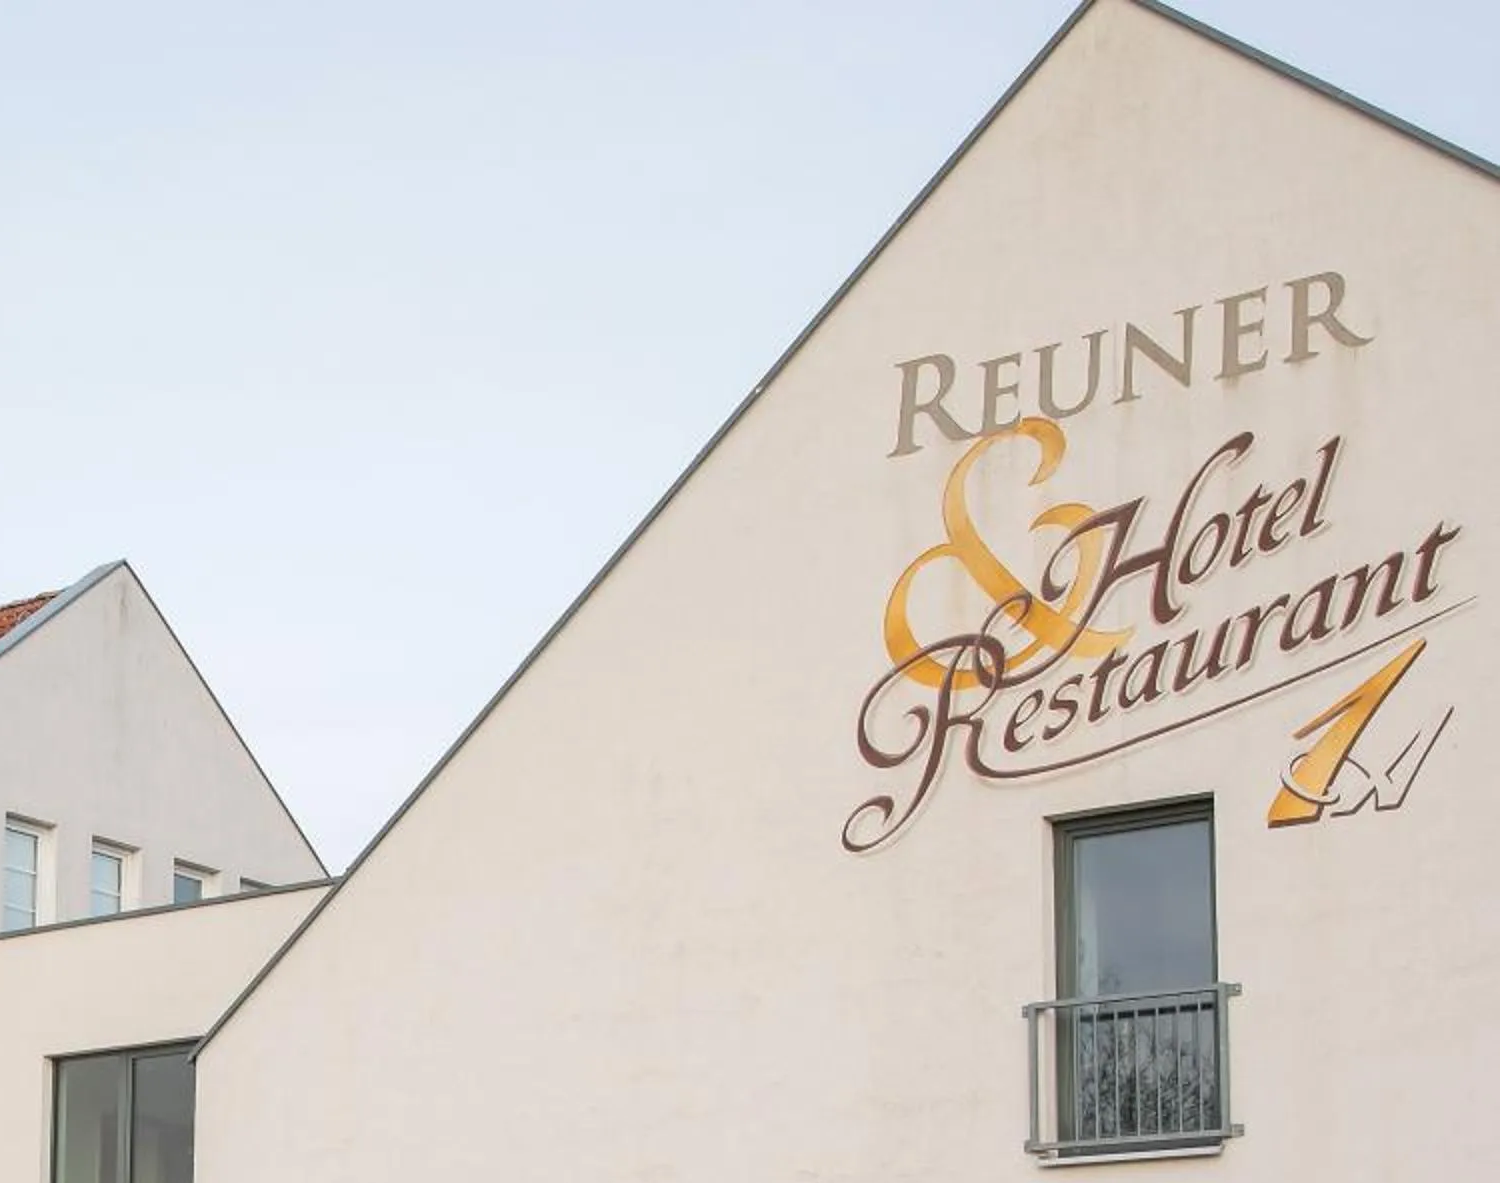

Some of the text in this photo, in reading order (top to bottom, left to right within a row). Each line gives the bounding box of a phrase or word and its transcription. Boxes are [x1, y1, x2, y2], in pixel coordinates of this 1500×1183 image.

[887, 270, 1376, 458] REUNER
[841, 520, 1470, 852] Restaurant
[883, 415, 1342, 690] & Hotel
